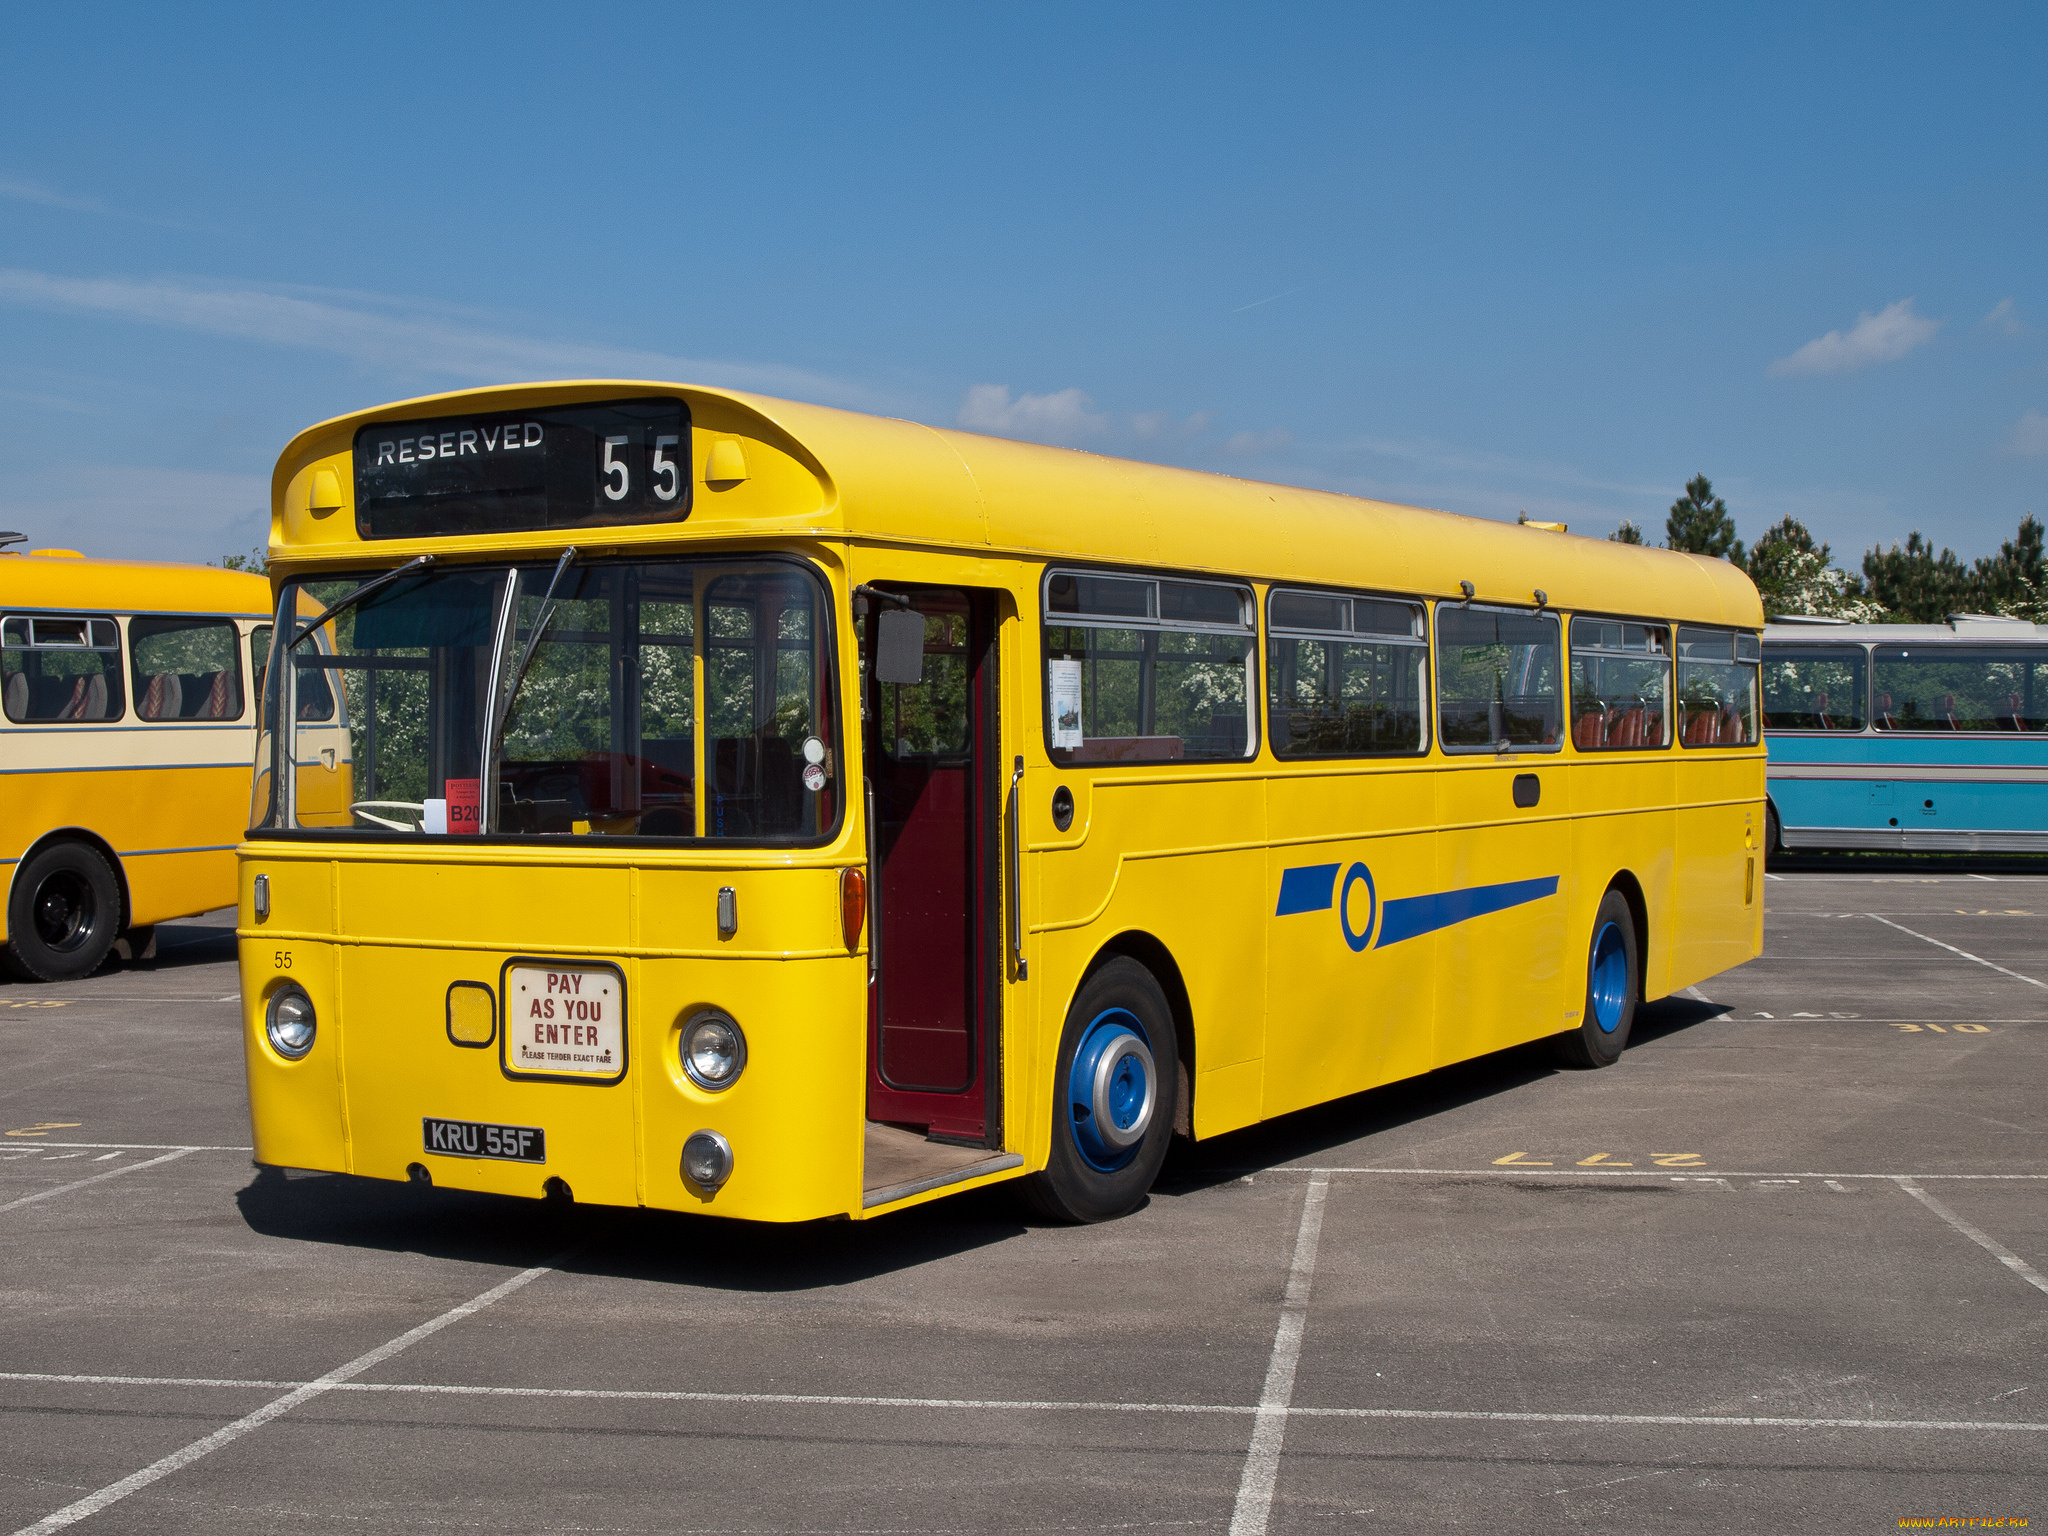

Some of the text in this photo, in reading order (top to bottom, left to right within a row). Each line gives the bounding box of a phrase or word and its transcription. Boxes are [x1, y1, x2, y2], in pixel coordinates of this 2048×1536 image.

[377, 421, 544, 466] RESERVED
[274, 951, 292, 969] 55
[547, 973, 582, 994] PAY
[530, 998, 601, 1022] AS YOU
[535, 1024, 598, 1046] ENTER
[1889, 1023, 1991, 1034] 310
[522, 1051, 611, 1063] PLEASE TENDER EXACT FARE
[431, 1122, 534, 1157] KRU 55F
